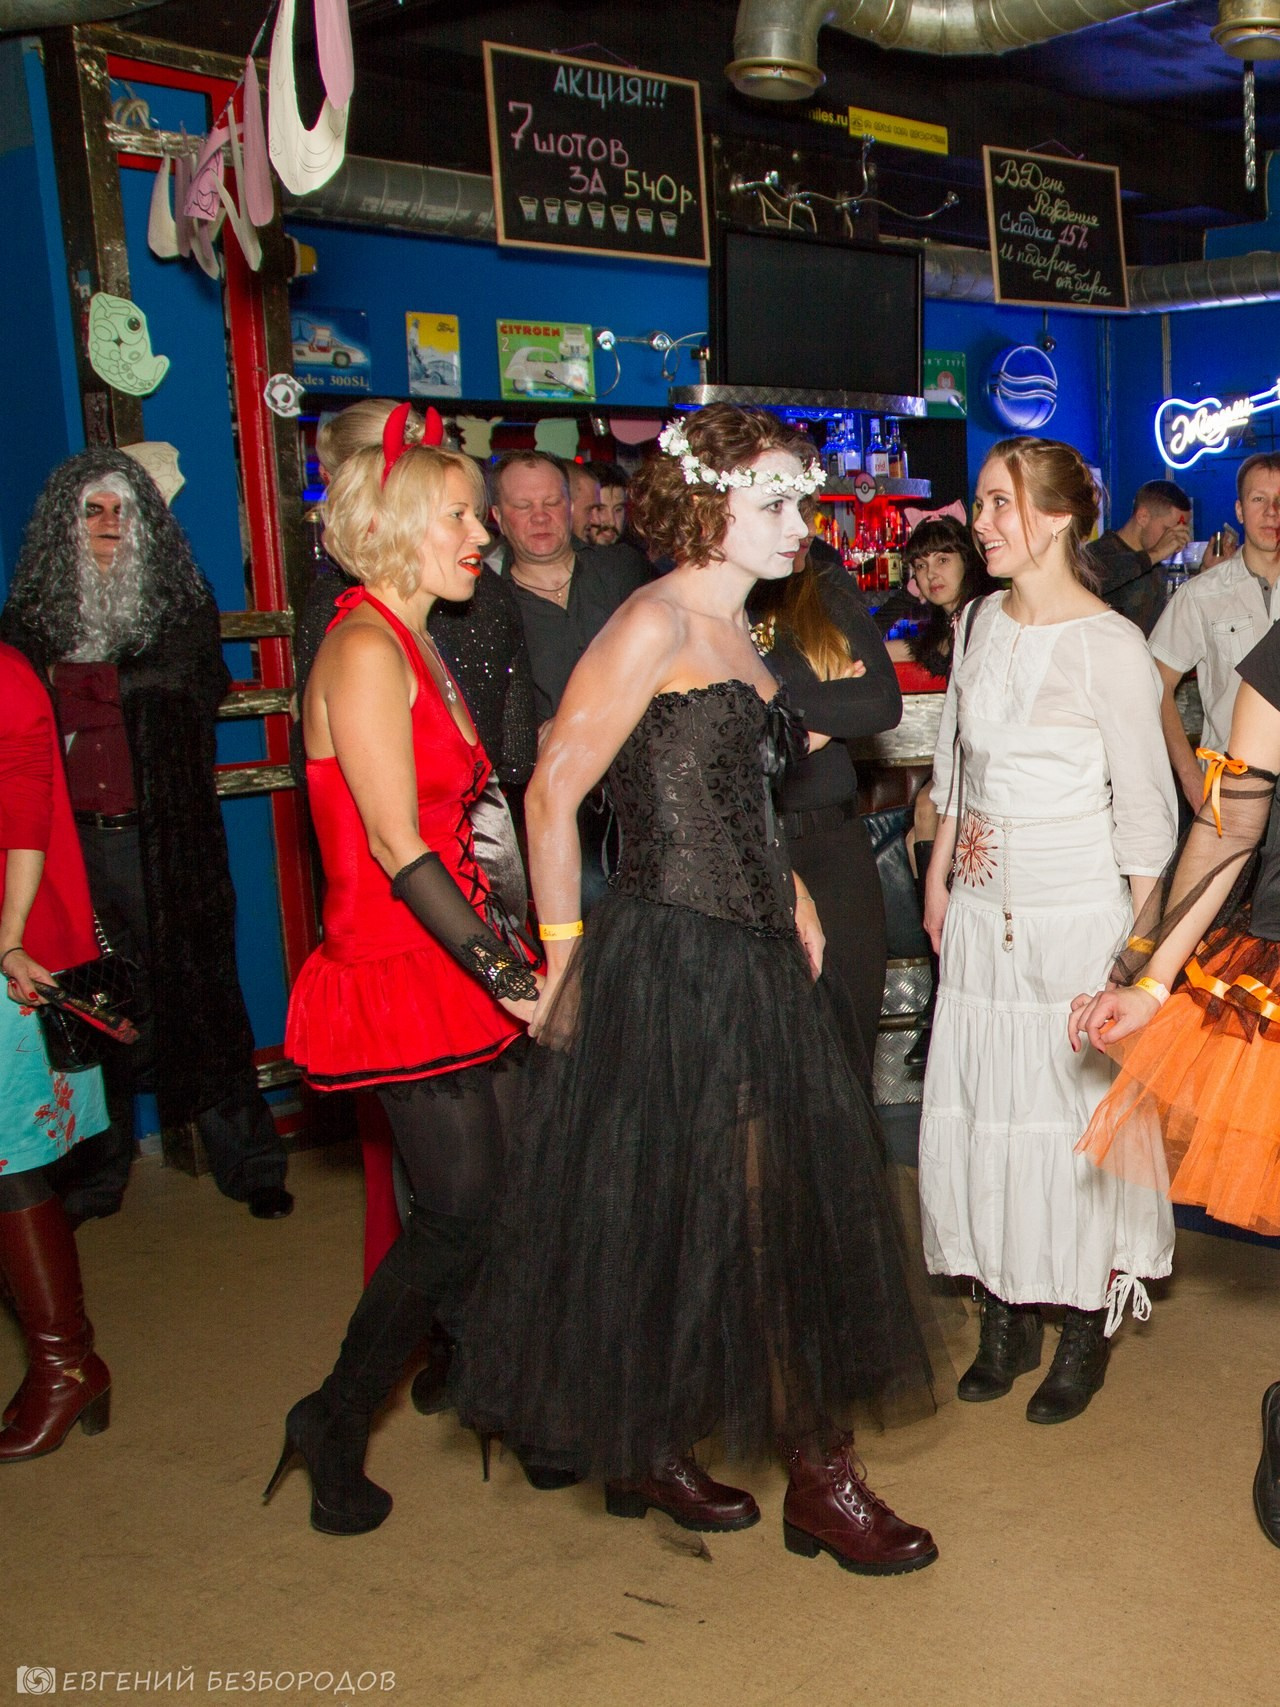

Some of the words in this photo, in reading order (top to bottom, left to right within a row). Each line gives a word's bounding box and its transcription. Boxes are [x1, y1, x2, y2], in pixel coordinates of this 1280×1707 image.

[553, 65, 667, 110] АКЦИЯ!!!
[508, 101, 533, 150] 7
[1000, 211, 1056, 242] Скидка
[1058, 223, 1089, 249] 15%
[295, 373, 325, 386] edes
[330, 375, 369, 387] 300SL
